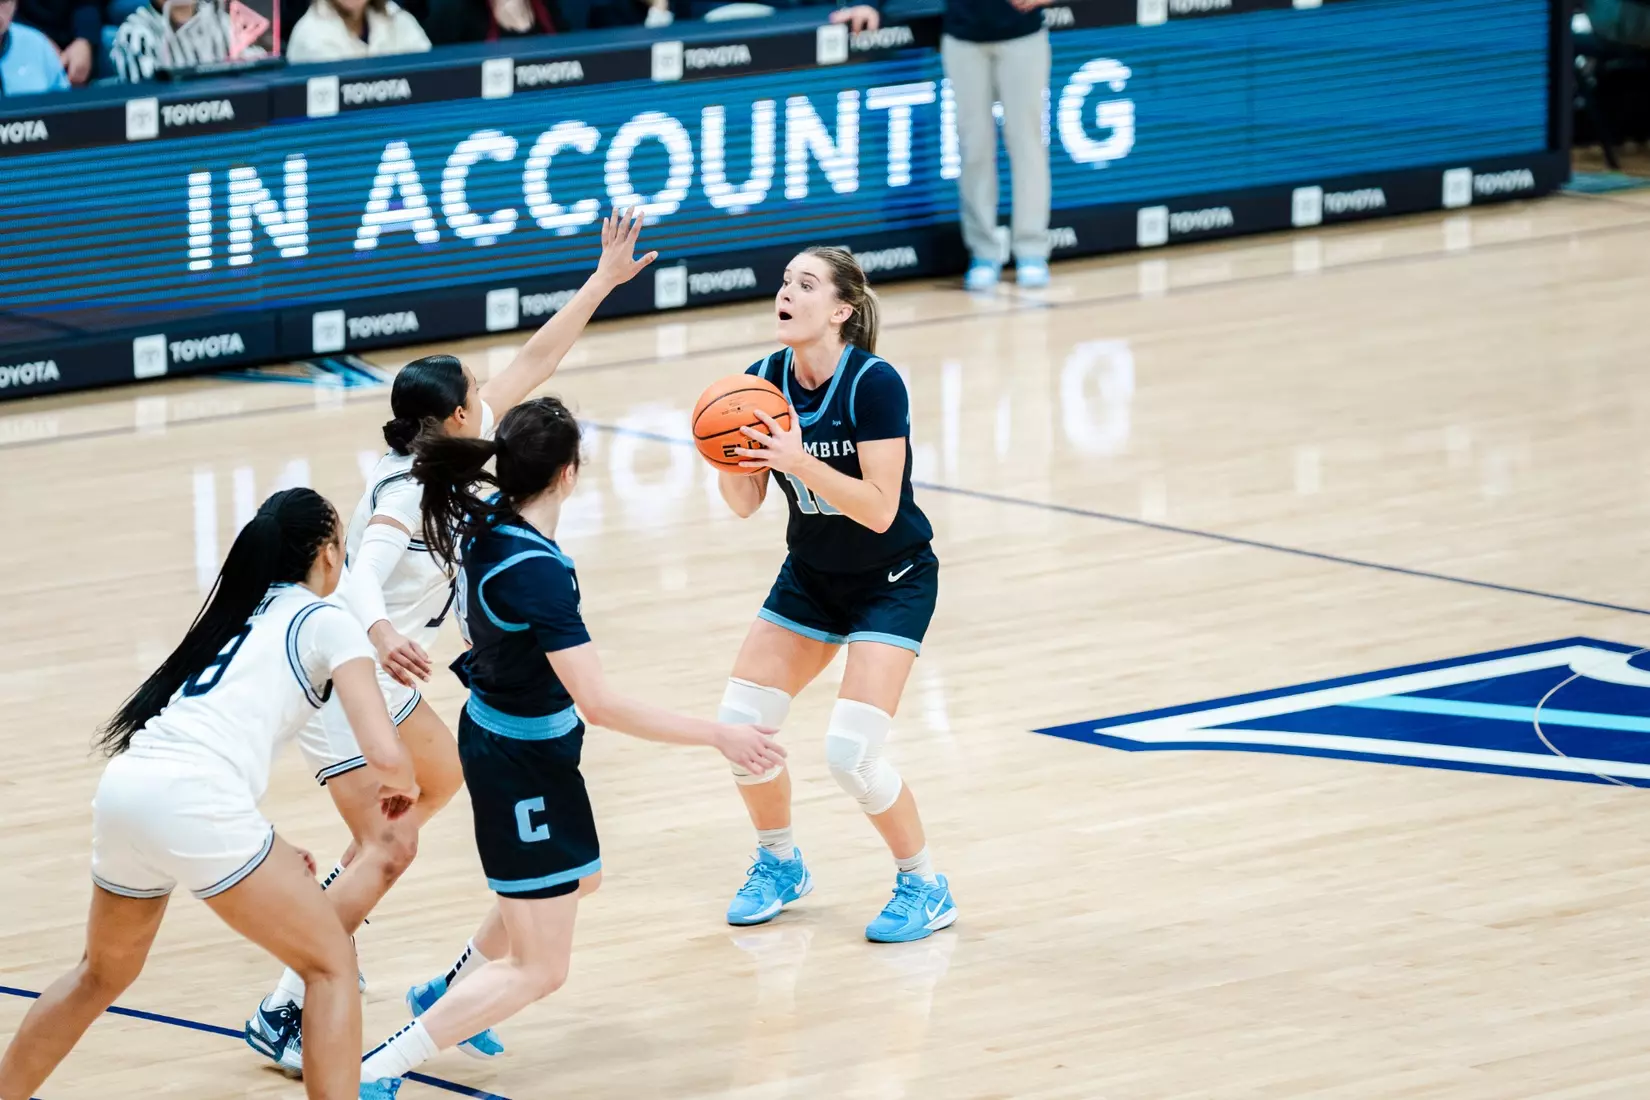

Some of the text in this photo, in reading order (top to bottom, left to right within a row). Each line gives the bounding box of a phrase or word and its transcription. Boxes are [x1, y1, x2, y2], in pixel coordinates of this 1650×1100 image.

[684, 45, 752, 69] TOYOTA
[515, 60, 584, 86] TOYOTA
[340, 78, 412, 106] TOYOTA
[161, 100, 235, 127] TOYOTA
[187, 57, 1136, 271] IN ACCOUNTIG
[1473, 168, 1535, 194] TOYOTA
[1323, 187, 1386, 214] TOYOTA
[1169, 206, 1234, 231] TOYOTA
[687, 267, 757, 295] TOYOTA
[346, 310, 419, 339] TOYOTA
[169, 332, 245, 363] TOYOTA
[784, 472, 845, 516] 1
[514, 796, 551, 843] C
